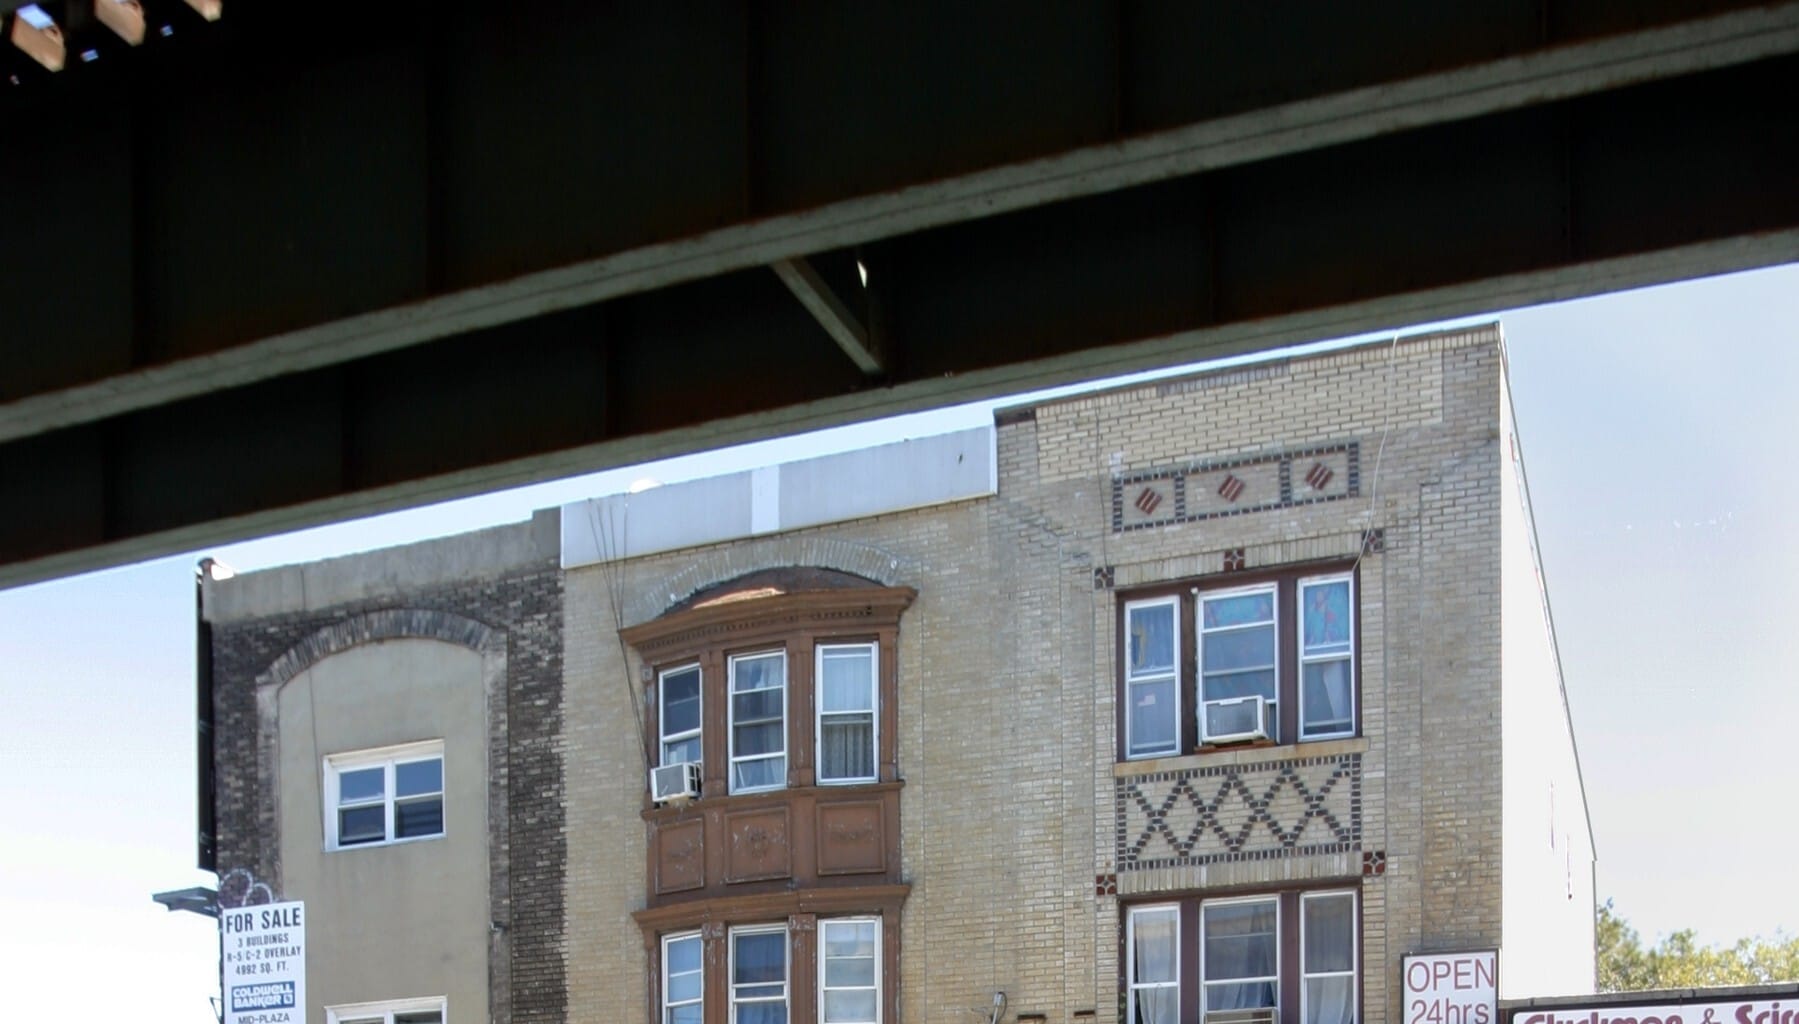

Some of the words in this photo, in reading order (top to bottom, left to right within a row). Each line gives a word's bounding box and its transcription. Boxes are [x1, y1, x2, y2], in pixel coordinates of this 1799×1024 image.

[226, 913, 253, 934] FOR
[261, 907, 301, 929] SALE
[238, 937, 243, 948] 3
[246, 933, 289, 947] BUILDINGS
[264, 945, 301, 959] OVERLAY
[1407, 958, 1495, 993] OPEN
[238, 1012, 290, 1024] MID-PLAZA
